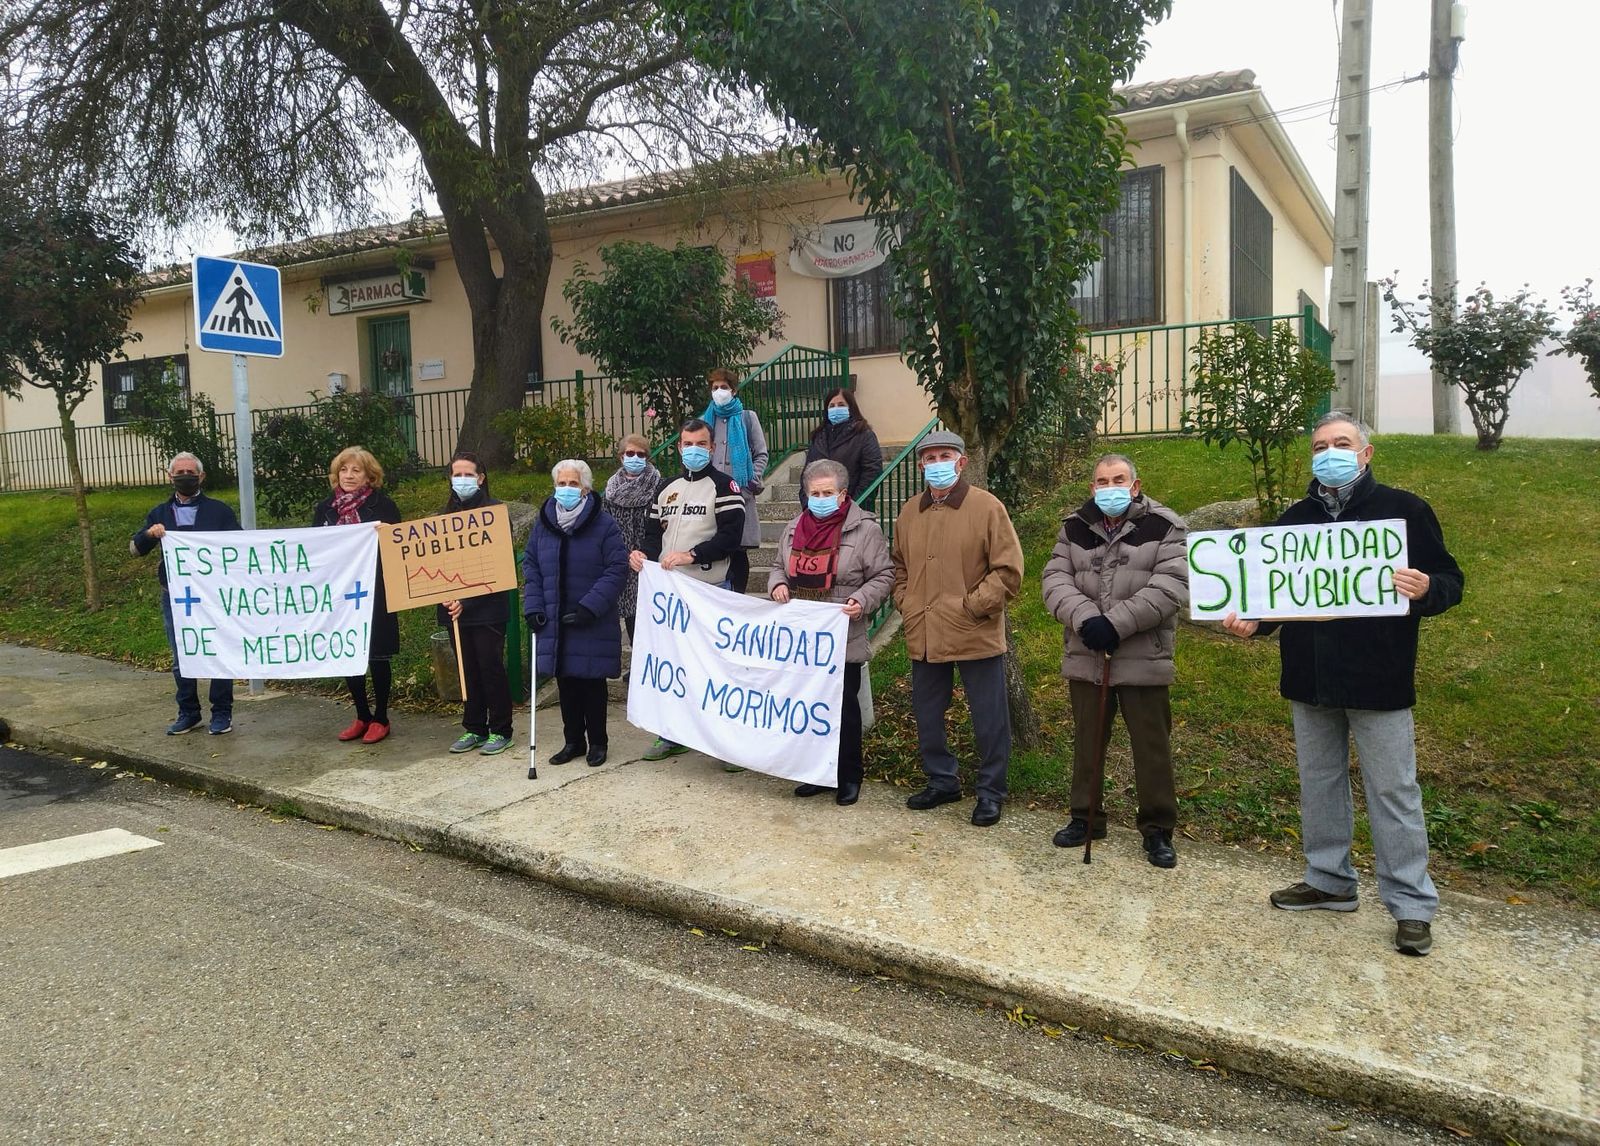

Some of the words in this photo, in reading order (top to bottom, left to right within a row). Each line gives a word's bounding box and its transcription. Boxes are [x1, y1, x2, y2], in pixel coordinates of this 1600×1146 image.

[833, 233, 855, 253] NO
[392, 510, 495, 544] SANIDAD
[164, 539, 311, 584] ¡ESPAÑA
[401, 530, 493, 561] PÚBLICA
[652, 591, 691, 633] SIN
[181, 627, 218, 657] DE
[641, 653, 687, 699] NOS
[701, 678, 832, 736] MORIMOS
